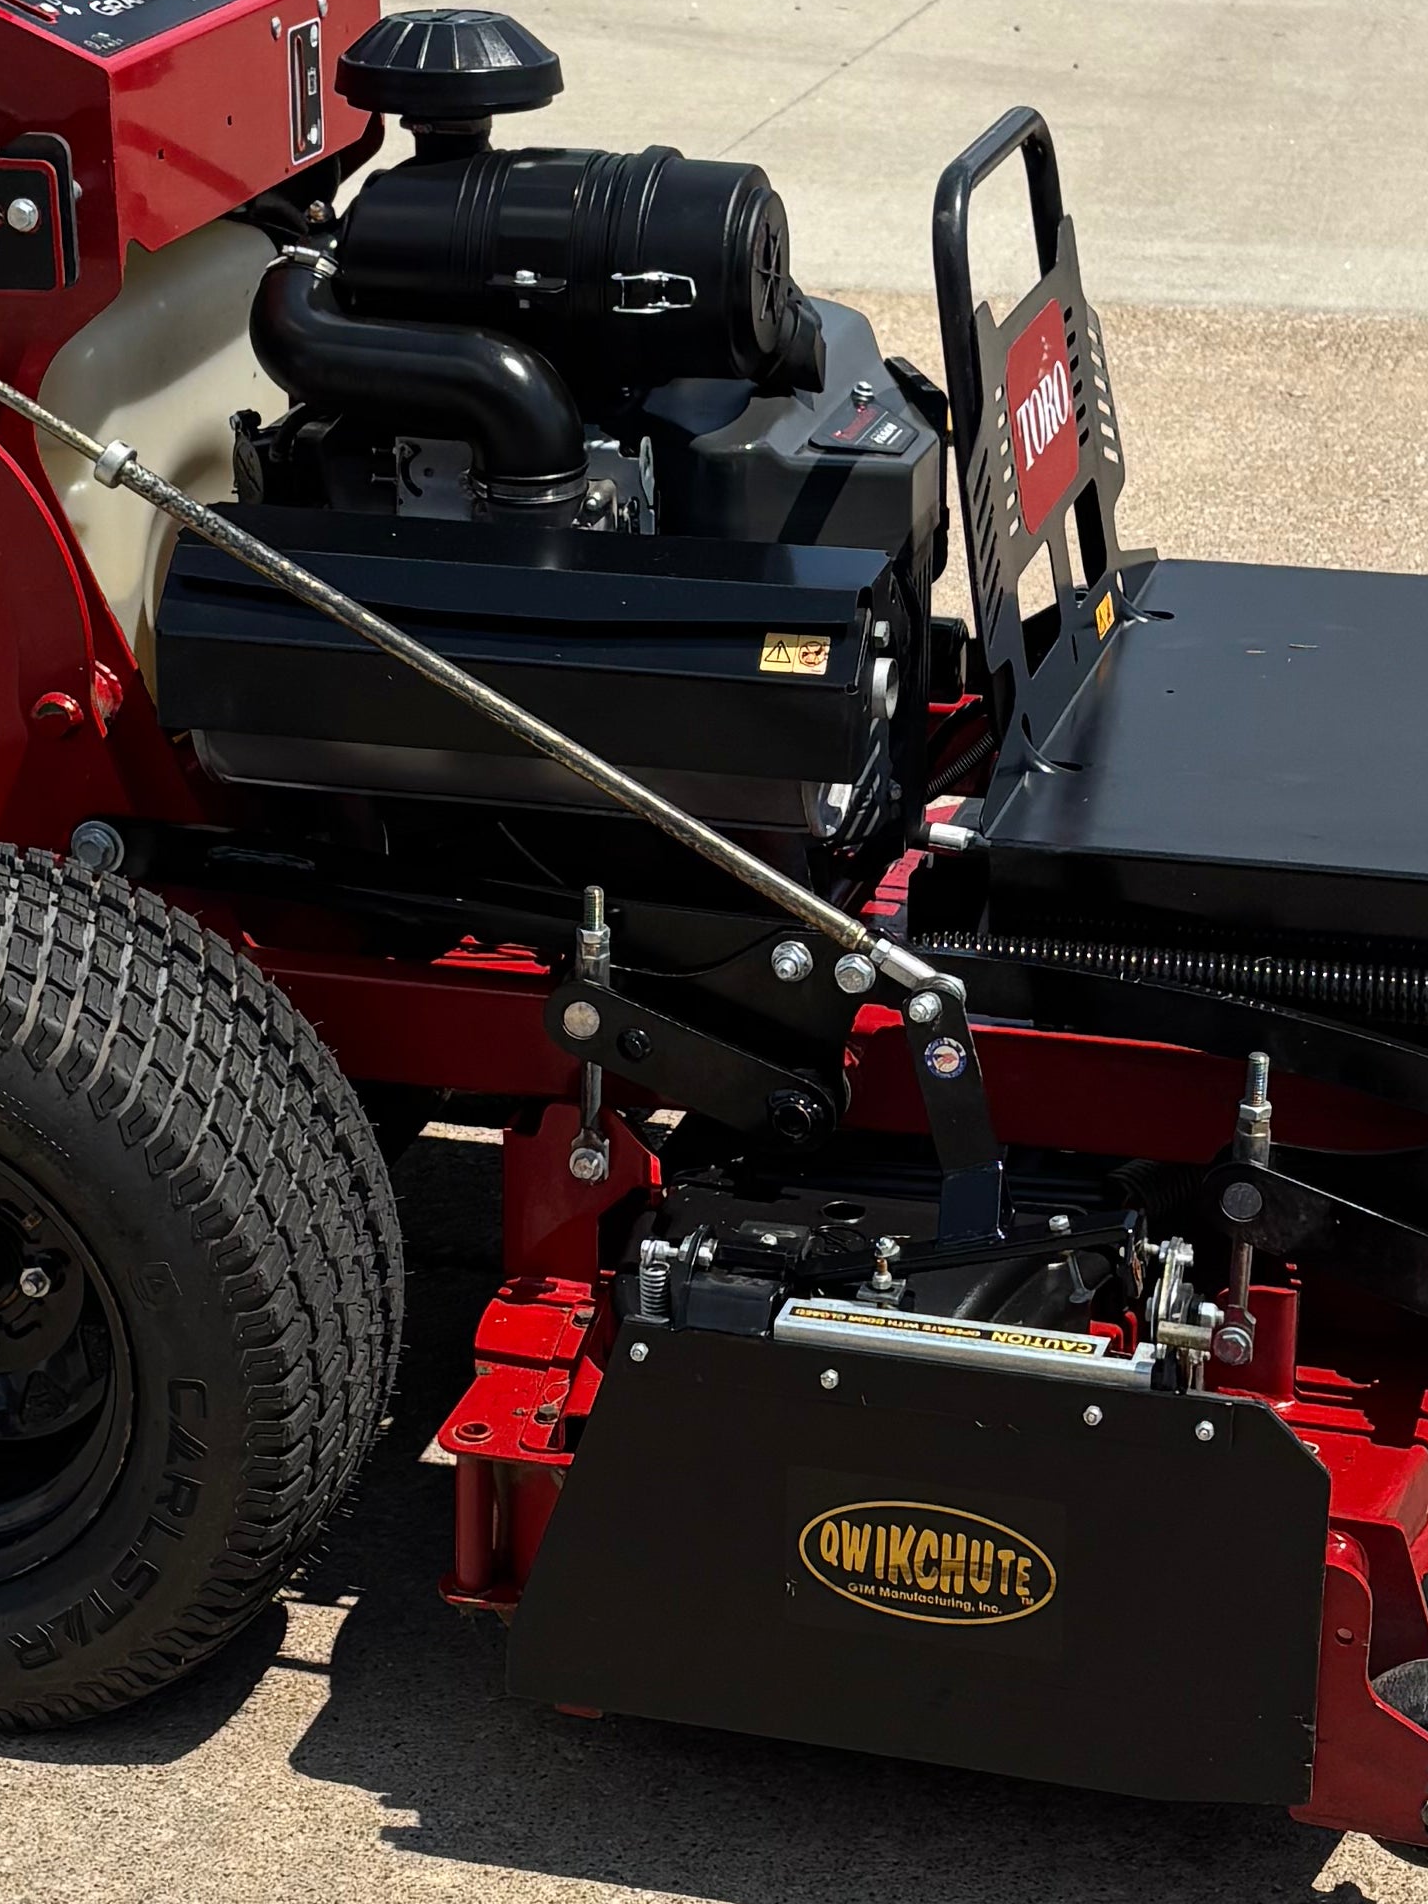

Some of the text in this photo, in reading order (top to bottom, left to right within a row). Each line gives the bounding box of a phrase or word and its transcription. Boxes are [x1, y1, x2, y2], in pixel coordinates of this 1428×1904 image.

[1016, 360, 1069, 471] TORO
[887, 1319, 919, 1330] WITH
[921, 1322, 981, 1337] OPERATE
[990, 1330, 1093, 1353] CAUTION
[819, 1519, 1033, 1597] QWIKCHUTE
[847, 1582, 1003, 1614] GTM Manufacturing, Inc.
